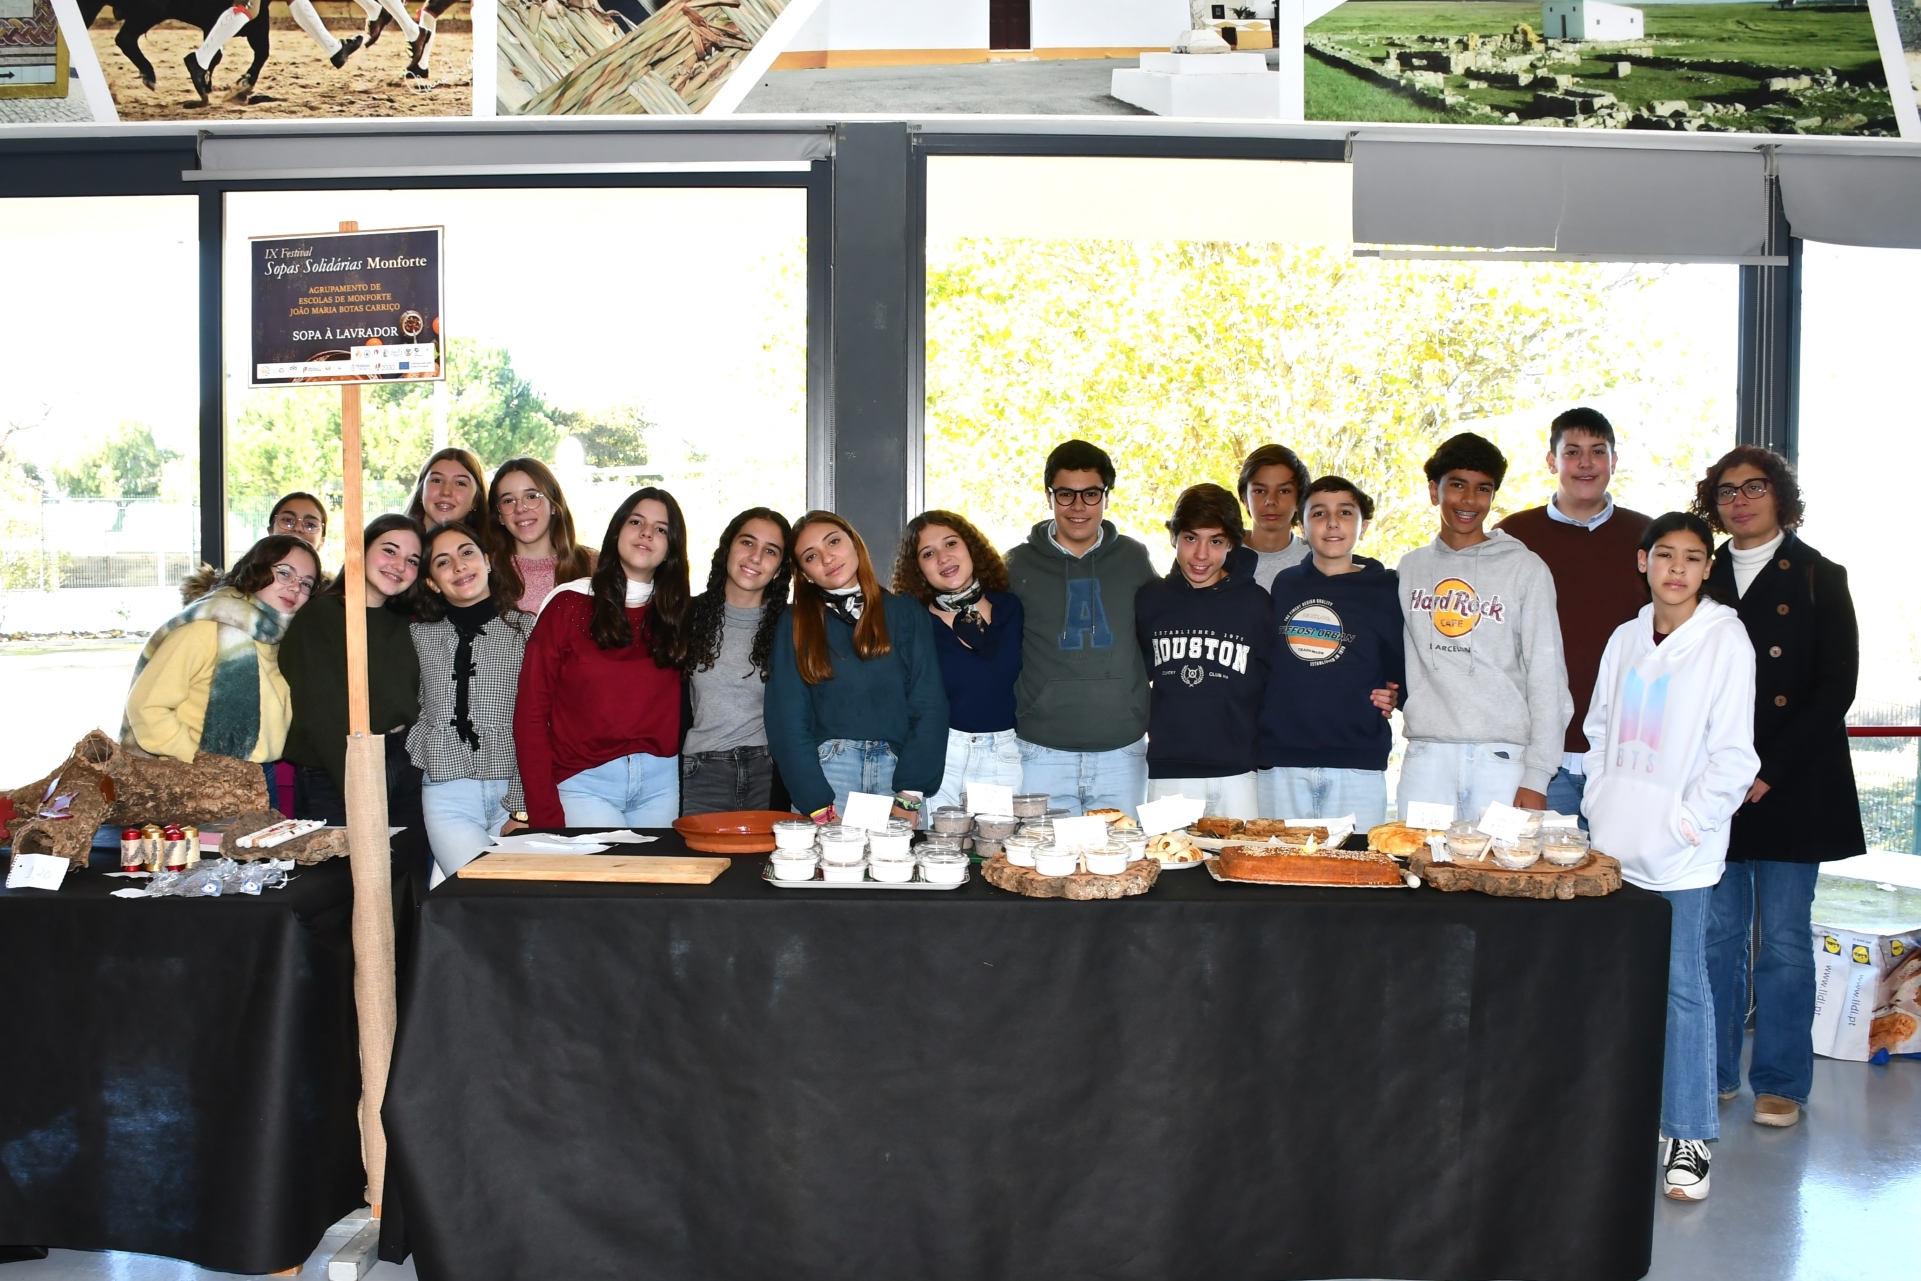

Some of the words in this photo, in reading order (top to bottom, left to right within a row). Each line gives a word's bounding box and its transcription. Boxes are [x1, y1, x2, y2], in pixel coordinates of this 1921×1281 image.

[265, 248, 279, 259] IX
[281, 246, 313, 258] Festival
[264, 261, 300, 279] Sopas
[303, 257, 363, 274] Solidárias
[367, 255, 427, 270] Monforte
[309, 284, 368, 294] AGRUPAMENTO
[370, 283, 381, 291] DE
[298, 296, 333, 305] ESCOLAS
[335, 295, 345, 303] DE
[347, 293, 392, 302] MONFORTE
[289, 307, 310, 316] JOÃO
[312, 306, 337, 315] MARIA
[339, 304, 364, 313] BOTAS
[365, 303, 400, 312] CARRIÇO
[292, 330, 322, 341] SOPA
[325, 327, 333, 339] À
[336, 326, 399, 339] LAVRADOR
[1410, 589, 1453, 611] Hard
[1453, 590, 1505, 623] Rock
[1058, 578, 1114, 651] A
[1440, 618, 1463, 627] CAFE
[1317, 629, 1356, 643] URBAN
[1616, 747, 1658, 773] BTS
[1814, 965, 1832, 1016] www.lidl.pt
[1848, 974, 1864, 1026] www.lidl.pt
